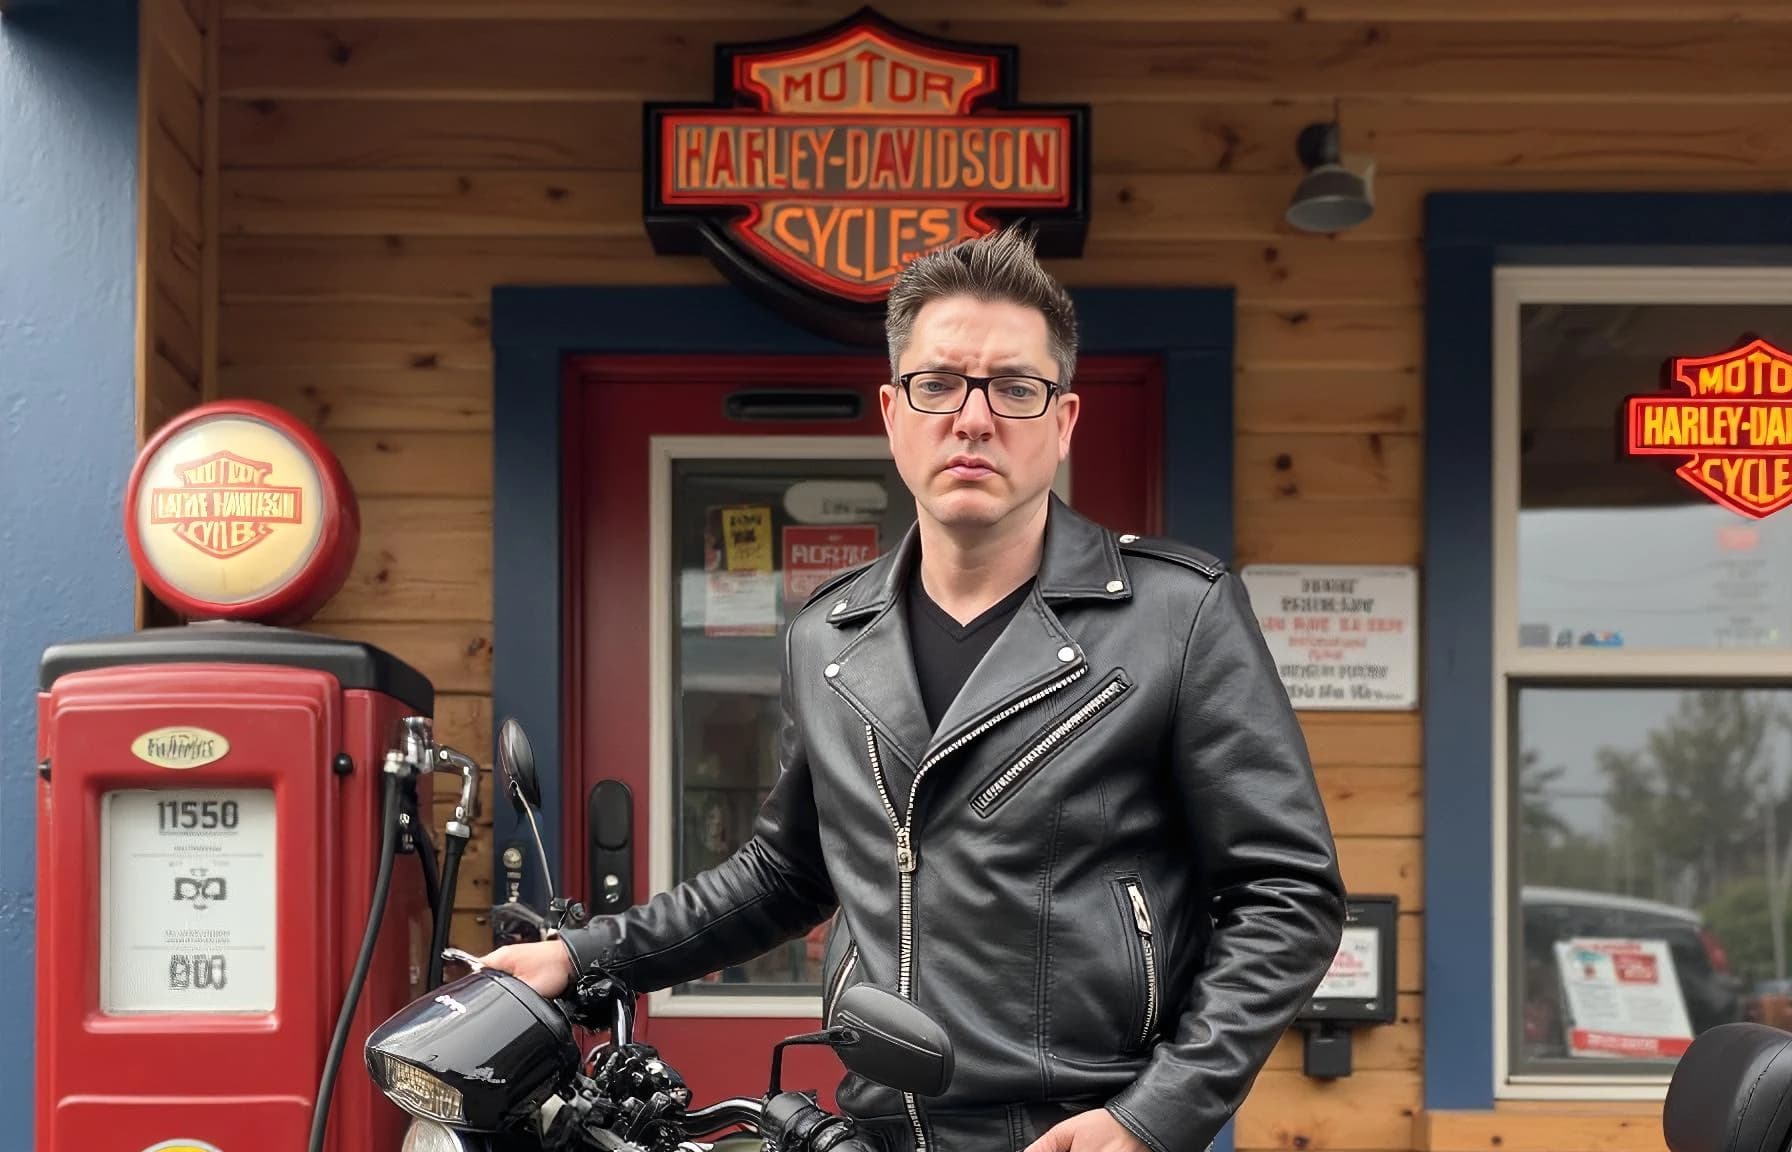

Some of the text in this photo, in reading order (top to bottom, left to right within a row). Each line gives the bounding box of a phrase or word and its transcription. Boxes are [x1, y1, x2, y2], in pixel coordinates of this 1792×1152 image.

[783, 51, 954, 112] MOTOR
[679, 127, 1057, 191] HARLEY-DAVIDSON
[774, 208, 951, 281] CYCLES
